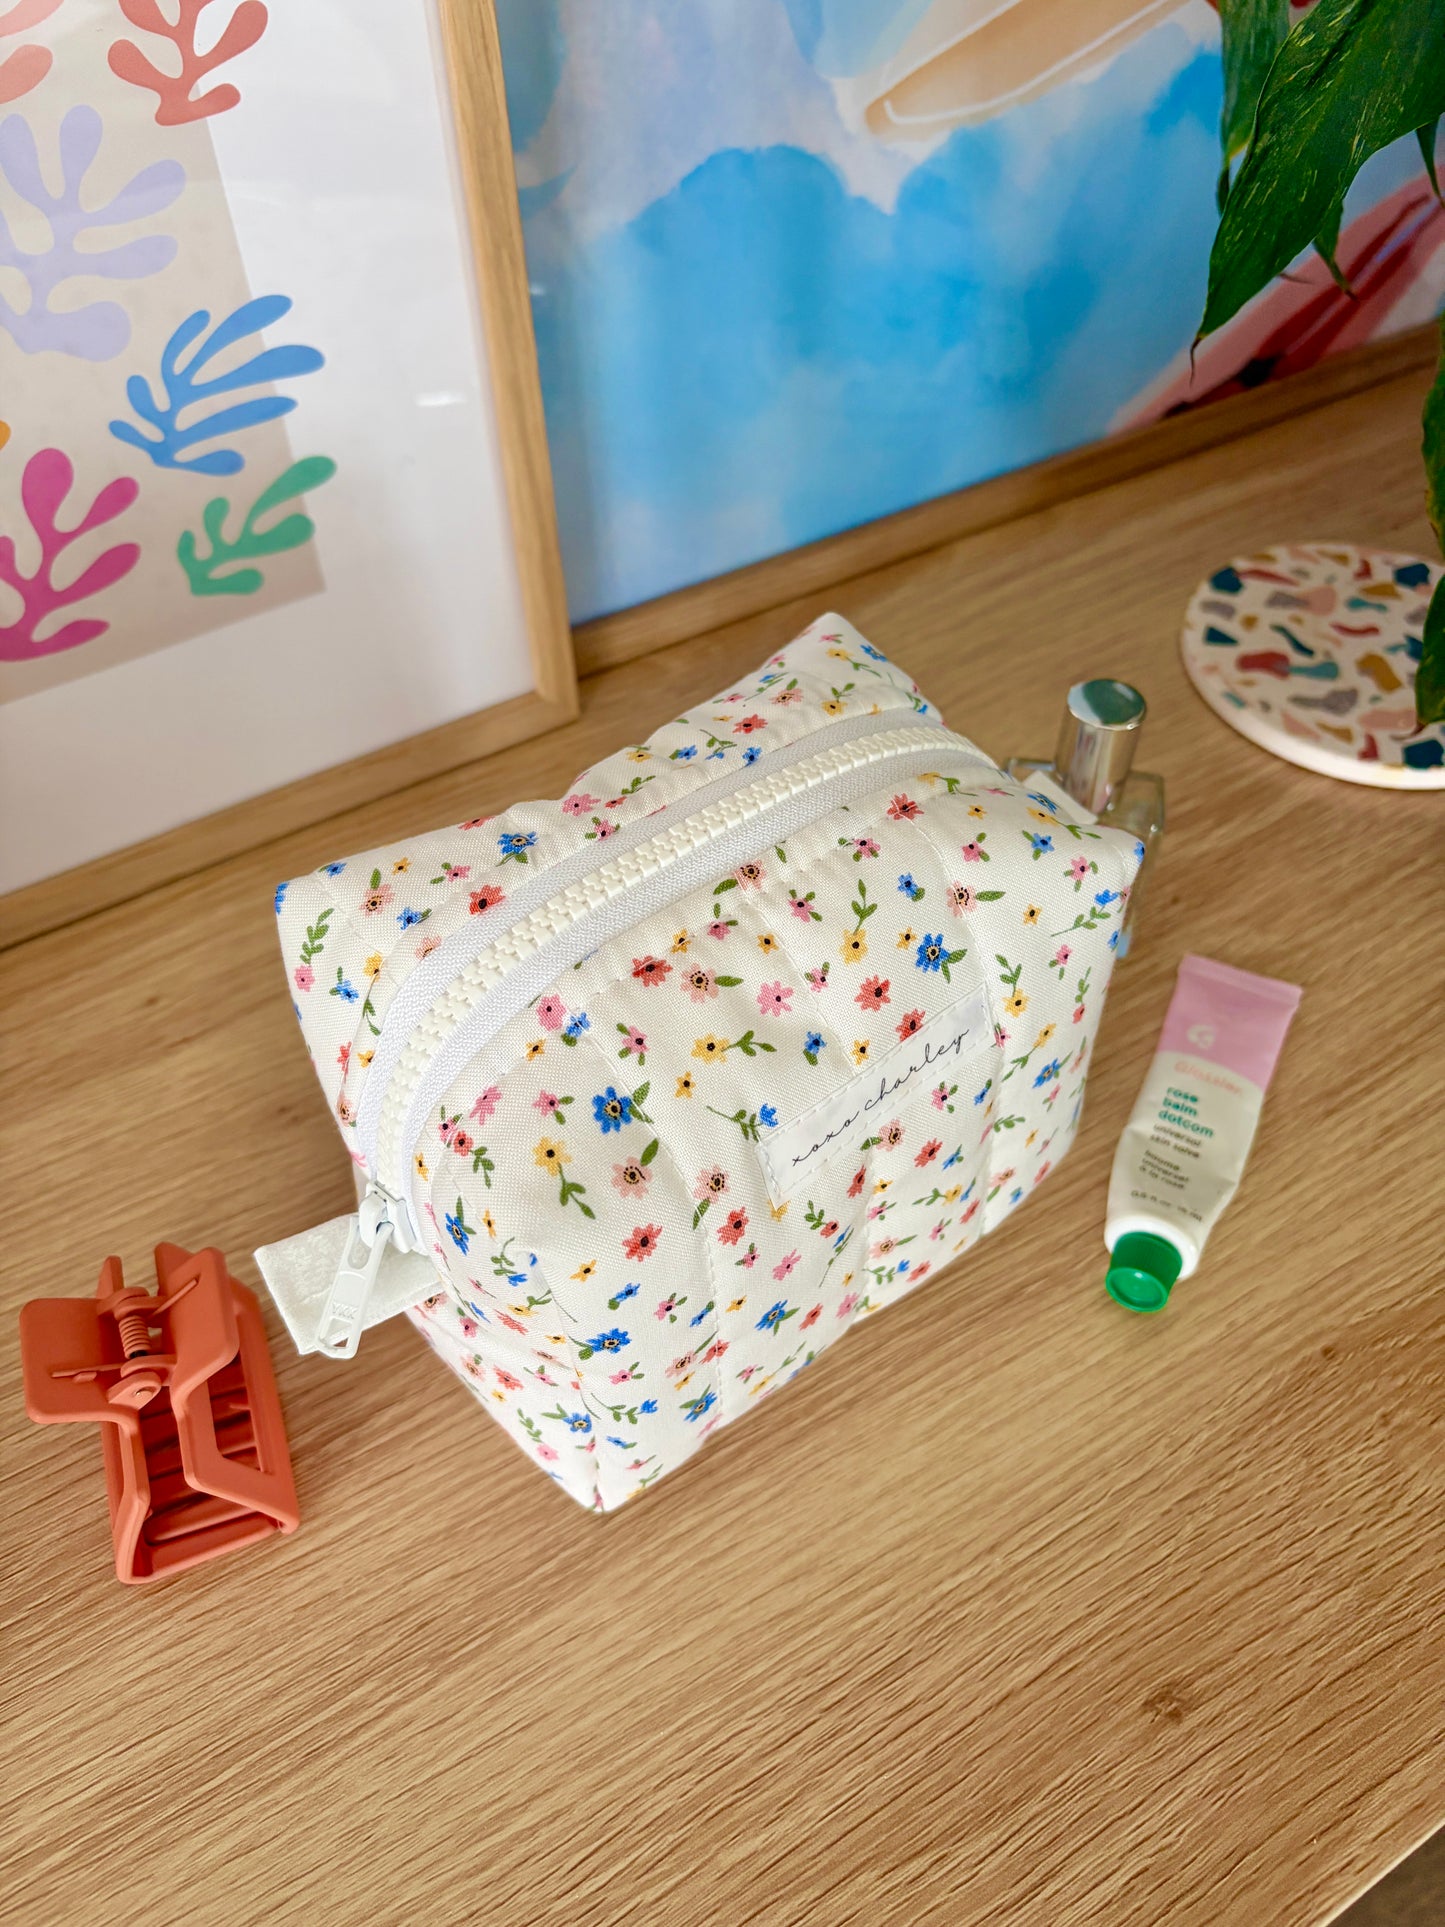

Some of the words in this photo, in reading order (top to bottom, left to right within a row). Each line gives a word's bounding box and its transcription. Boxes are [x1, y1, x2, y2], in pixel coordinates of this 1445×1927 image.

[792, 1111, 860, 1166] xoxo
[864, 1029, 970, 1110] charley
[1166, 1087, 1199, 1103] rose
[1162, 1097, 1198, 1117] balm
[1158, 1109, 1214, 1138] dotcom
[1153, 1124, 1202, 1147] universal
[332, 1301, 358, 1319] YKK
